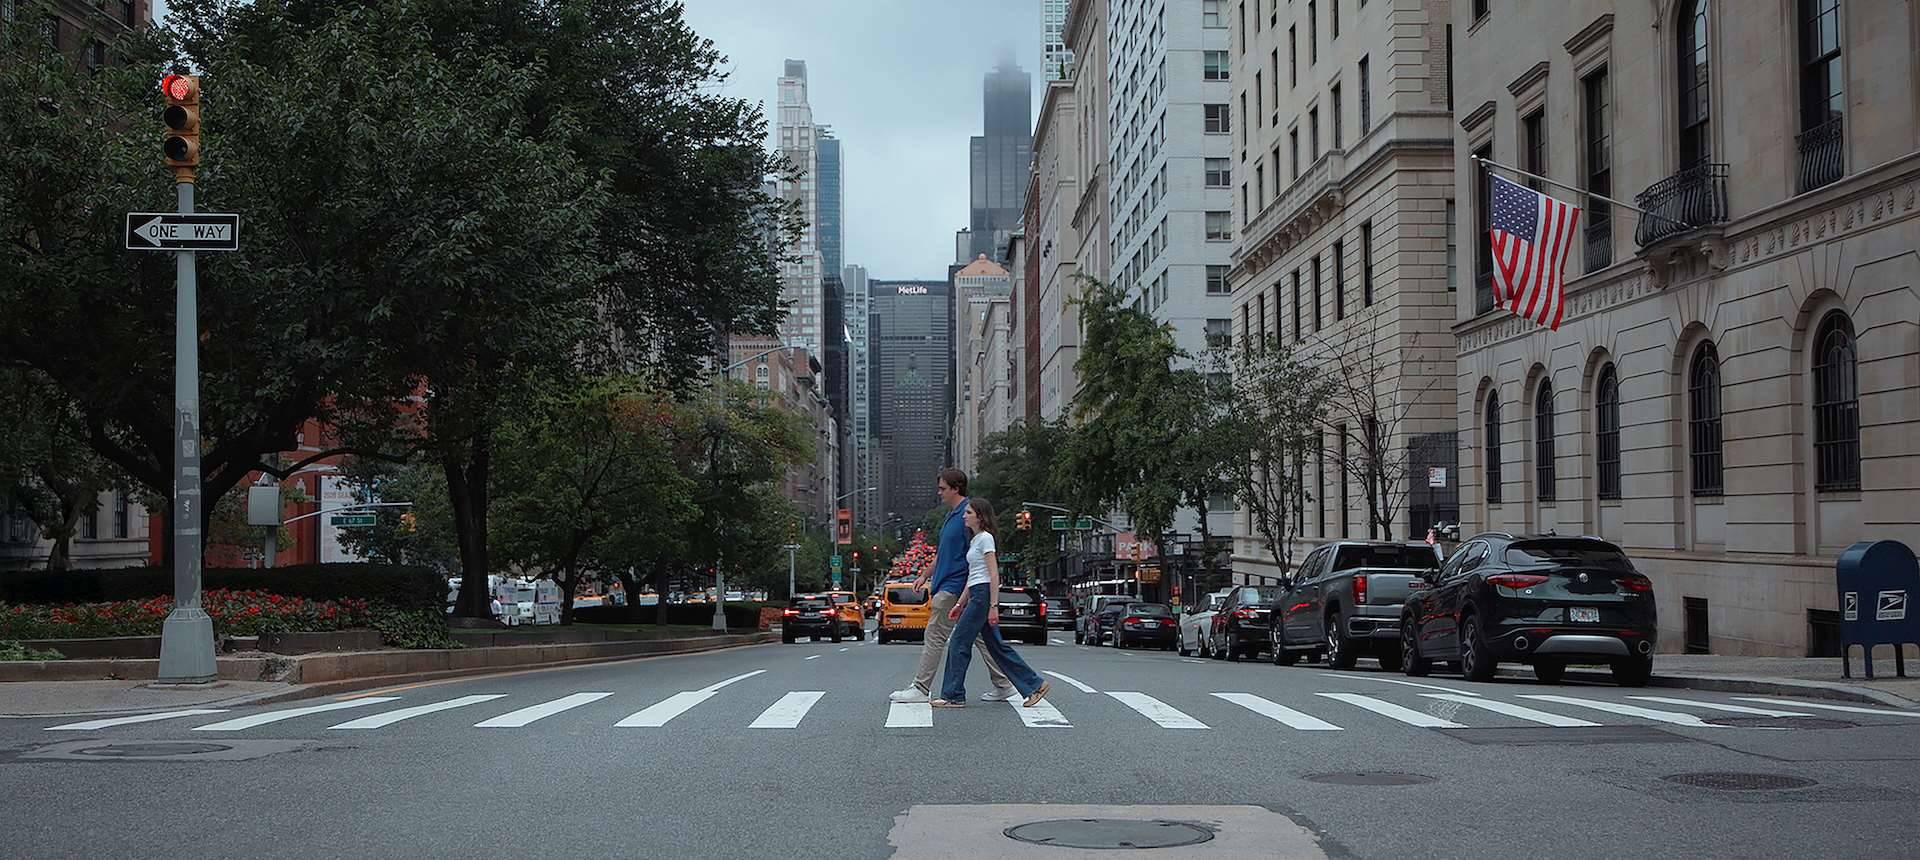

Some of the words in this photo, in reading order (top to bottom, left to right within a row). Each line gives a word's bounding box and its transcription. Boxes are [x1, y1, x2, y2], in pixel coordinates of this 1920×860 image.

[149, 224, 179, 238] ONE
[193, 225, 225, 239] WAY
[898, 286, 928, 294] MetLife
